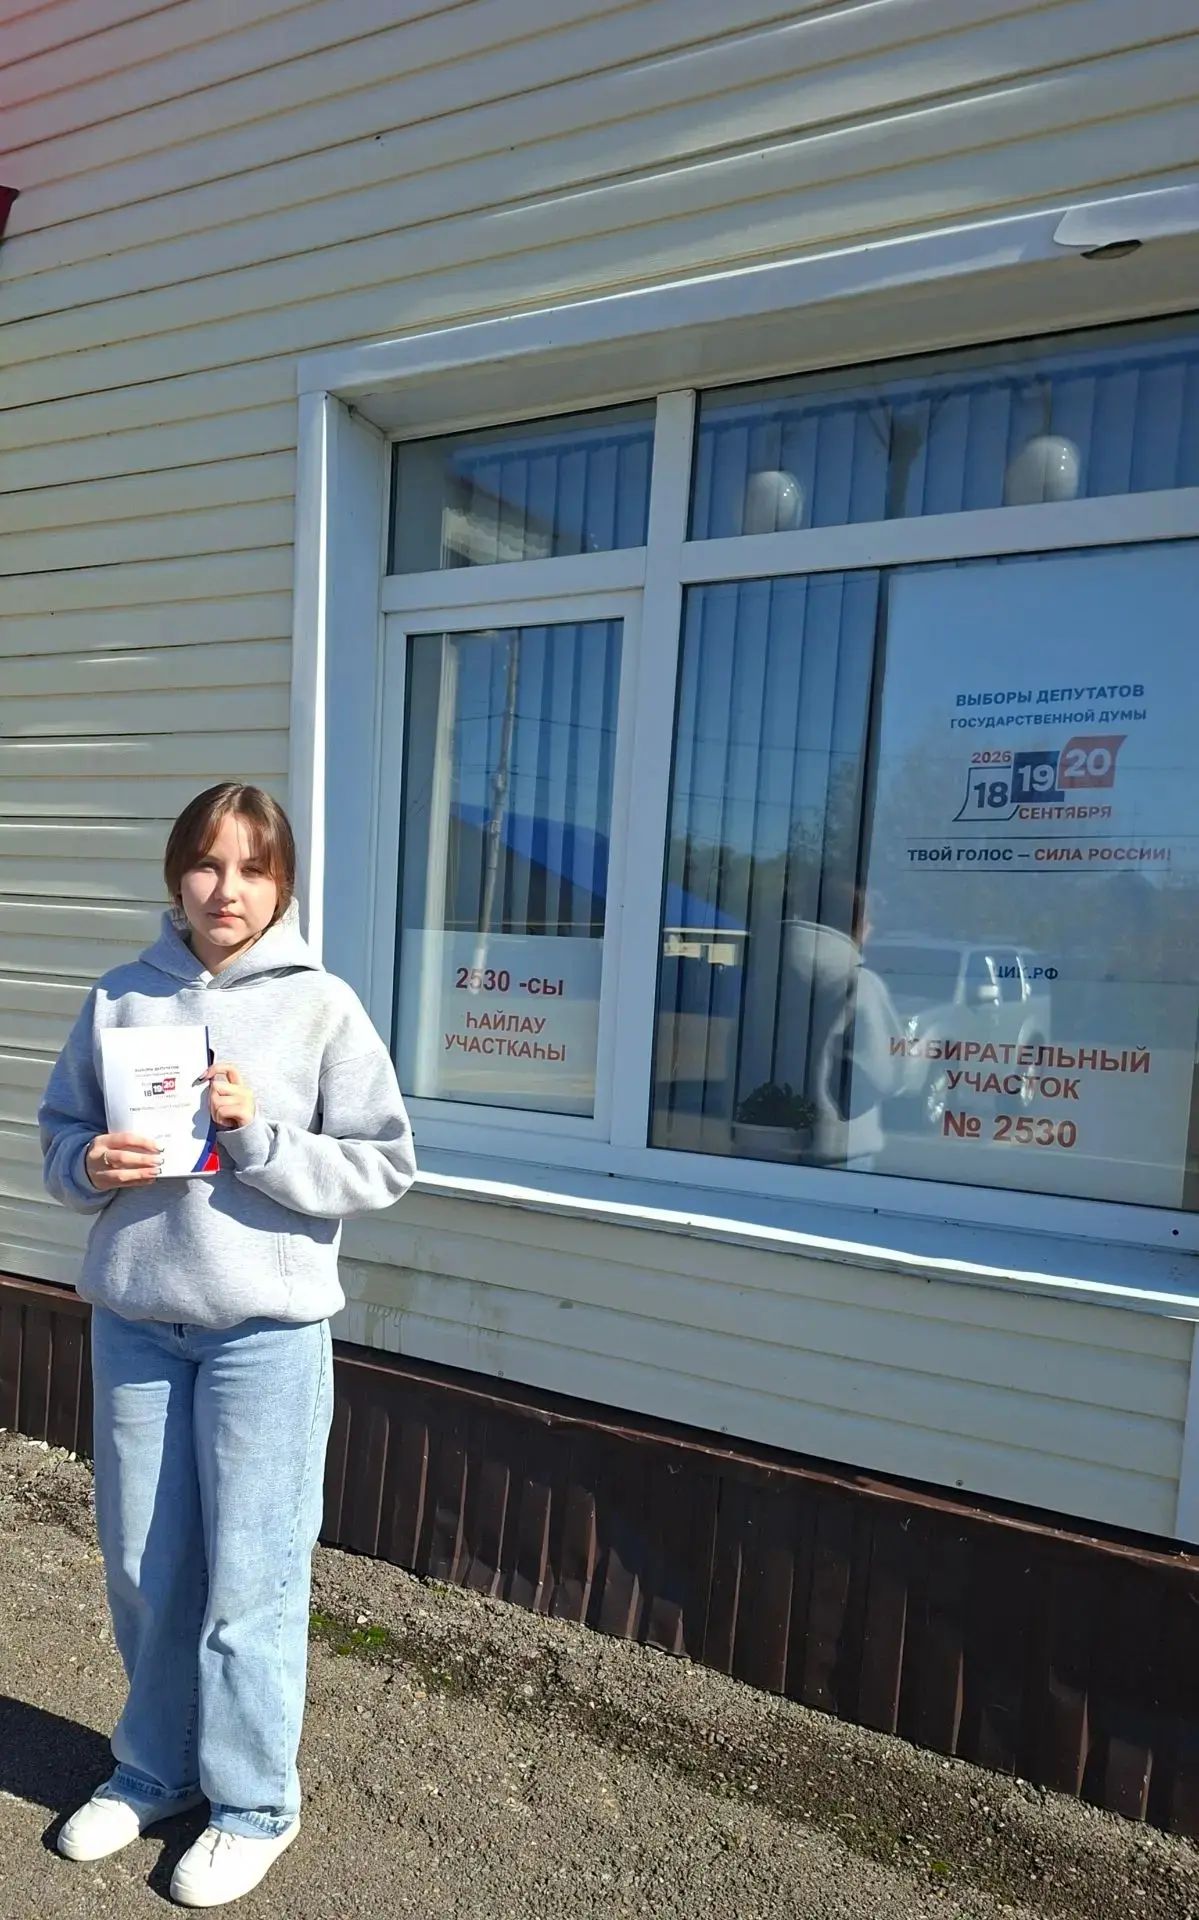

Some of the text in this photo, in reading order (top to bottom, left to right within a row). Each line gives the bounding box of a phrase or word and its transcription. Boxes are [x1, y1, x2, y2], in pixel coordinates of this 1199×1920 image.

[956, 684, 1145, 707] ВЫБОРЫ ДЕПУТАТОВ
[951, 709, 1147, 728] ГОСУДАРСТВЕННОЙ ДУМЫ
[971, 751, 1011, 764] 2026
[973, 748, 1111, 808] 18 19 20
[1019, 806, 1112, 820] СЕНТЯБРЯ
[907, 846, 952, 861] ТВОЙ
[956, 849, 1013, 861] ГОЛОС
[1034, 848, 1082, 861] СИЛА
[1088, 848, 1171, 861] РОССИИ!
[456, 967, 510, 992] 2530
[889, 1037, 1151, 1074] ИЗБИРАТЕЛЬНЫЙ
[163, 1080, 174, 1088] 20
[946, 1070, 1080, 1100] УЧАСТОК
[943, 1111, 1077, 1148] № 2530
